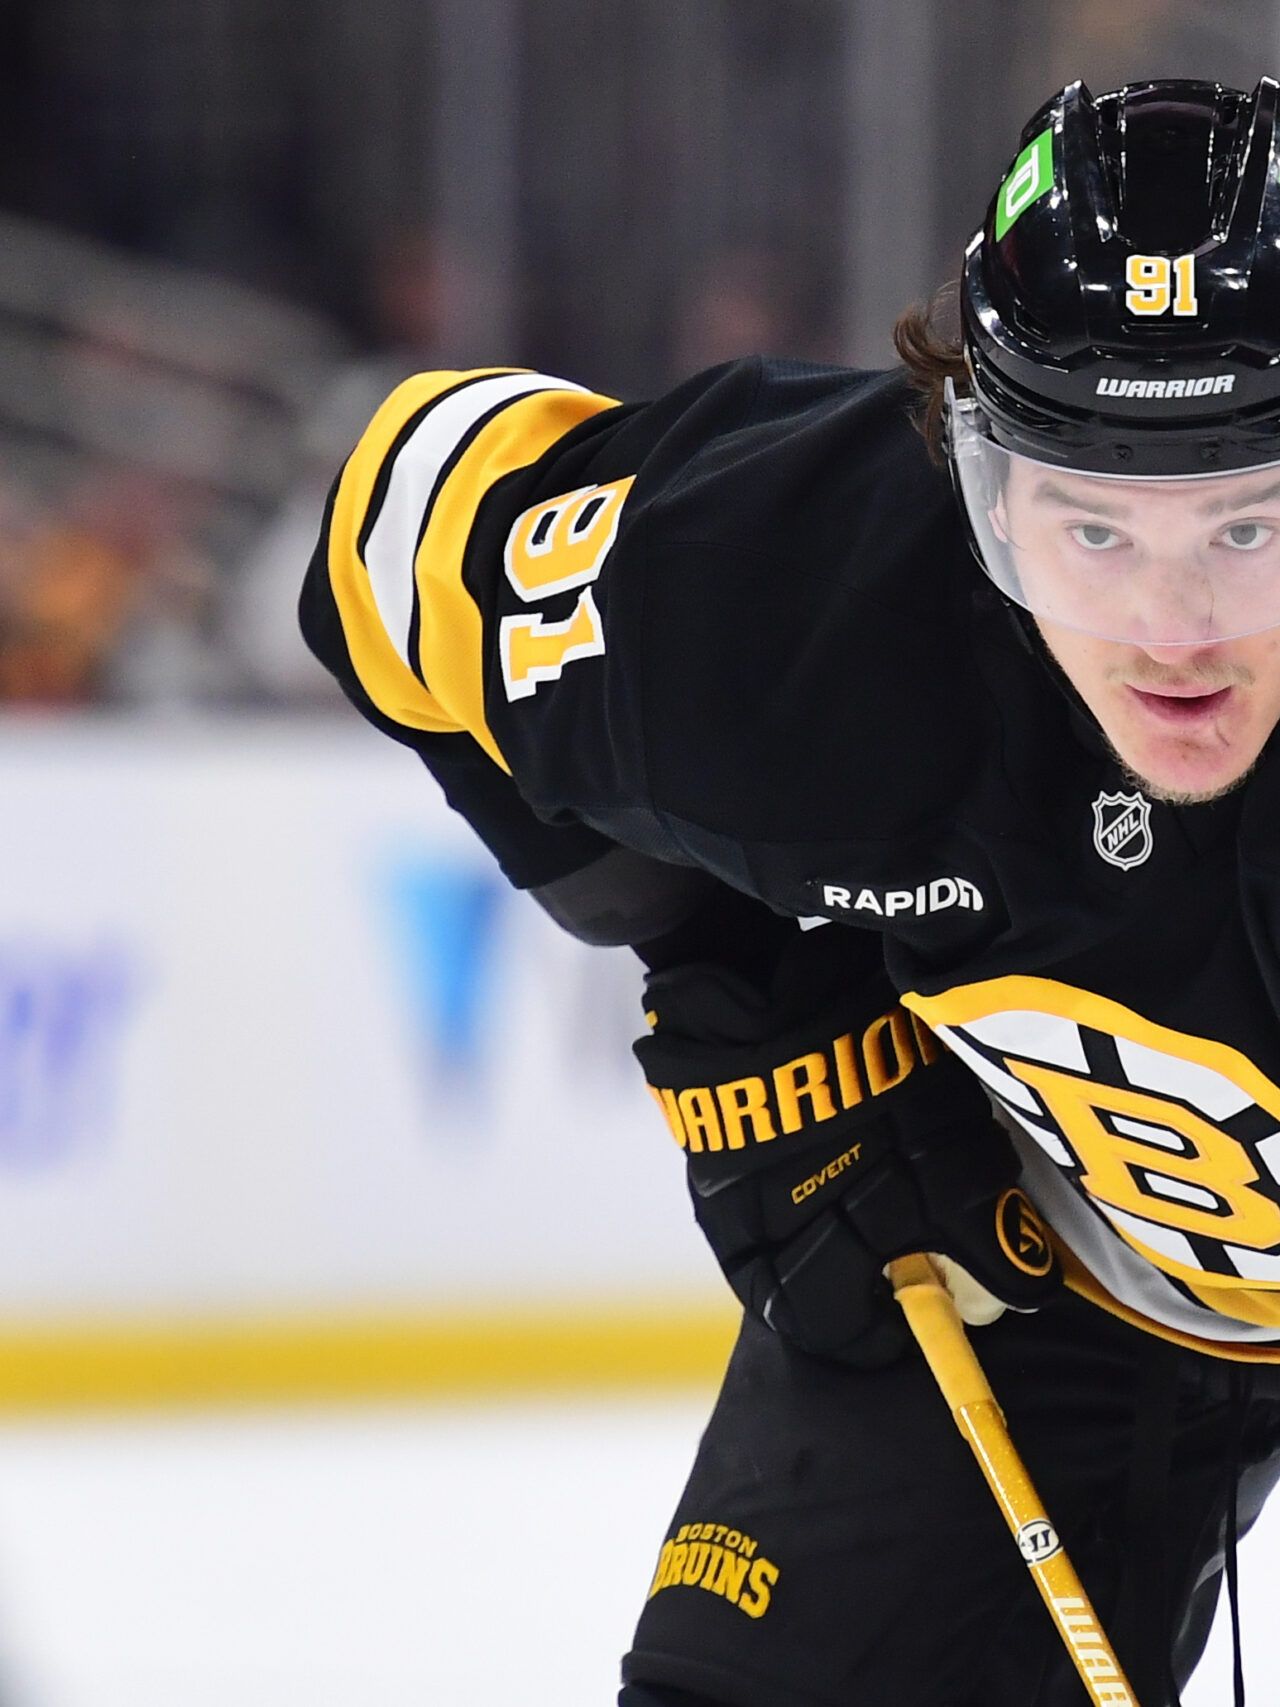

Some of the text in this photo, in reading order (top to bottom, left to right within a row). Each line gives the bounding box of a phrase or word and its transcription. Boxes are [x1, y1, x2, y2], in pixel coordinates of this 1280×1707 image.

[1125, 254, 1199, 316] 91
[1096, 374, 1236, 399] WARRIOR
[500, 473, 638, 703] 91
[1107, 812, 1140, 852] NHL
[790, 1143, 862, 1205] COVERT
[675, 1522, 759, 1558] BOSTON
